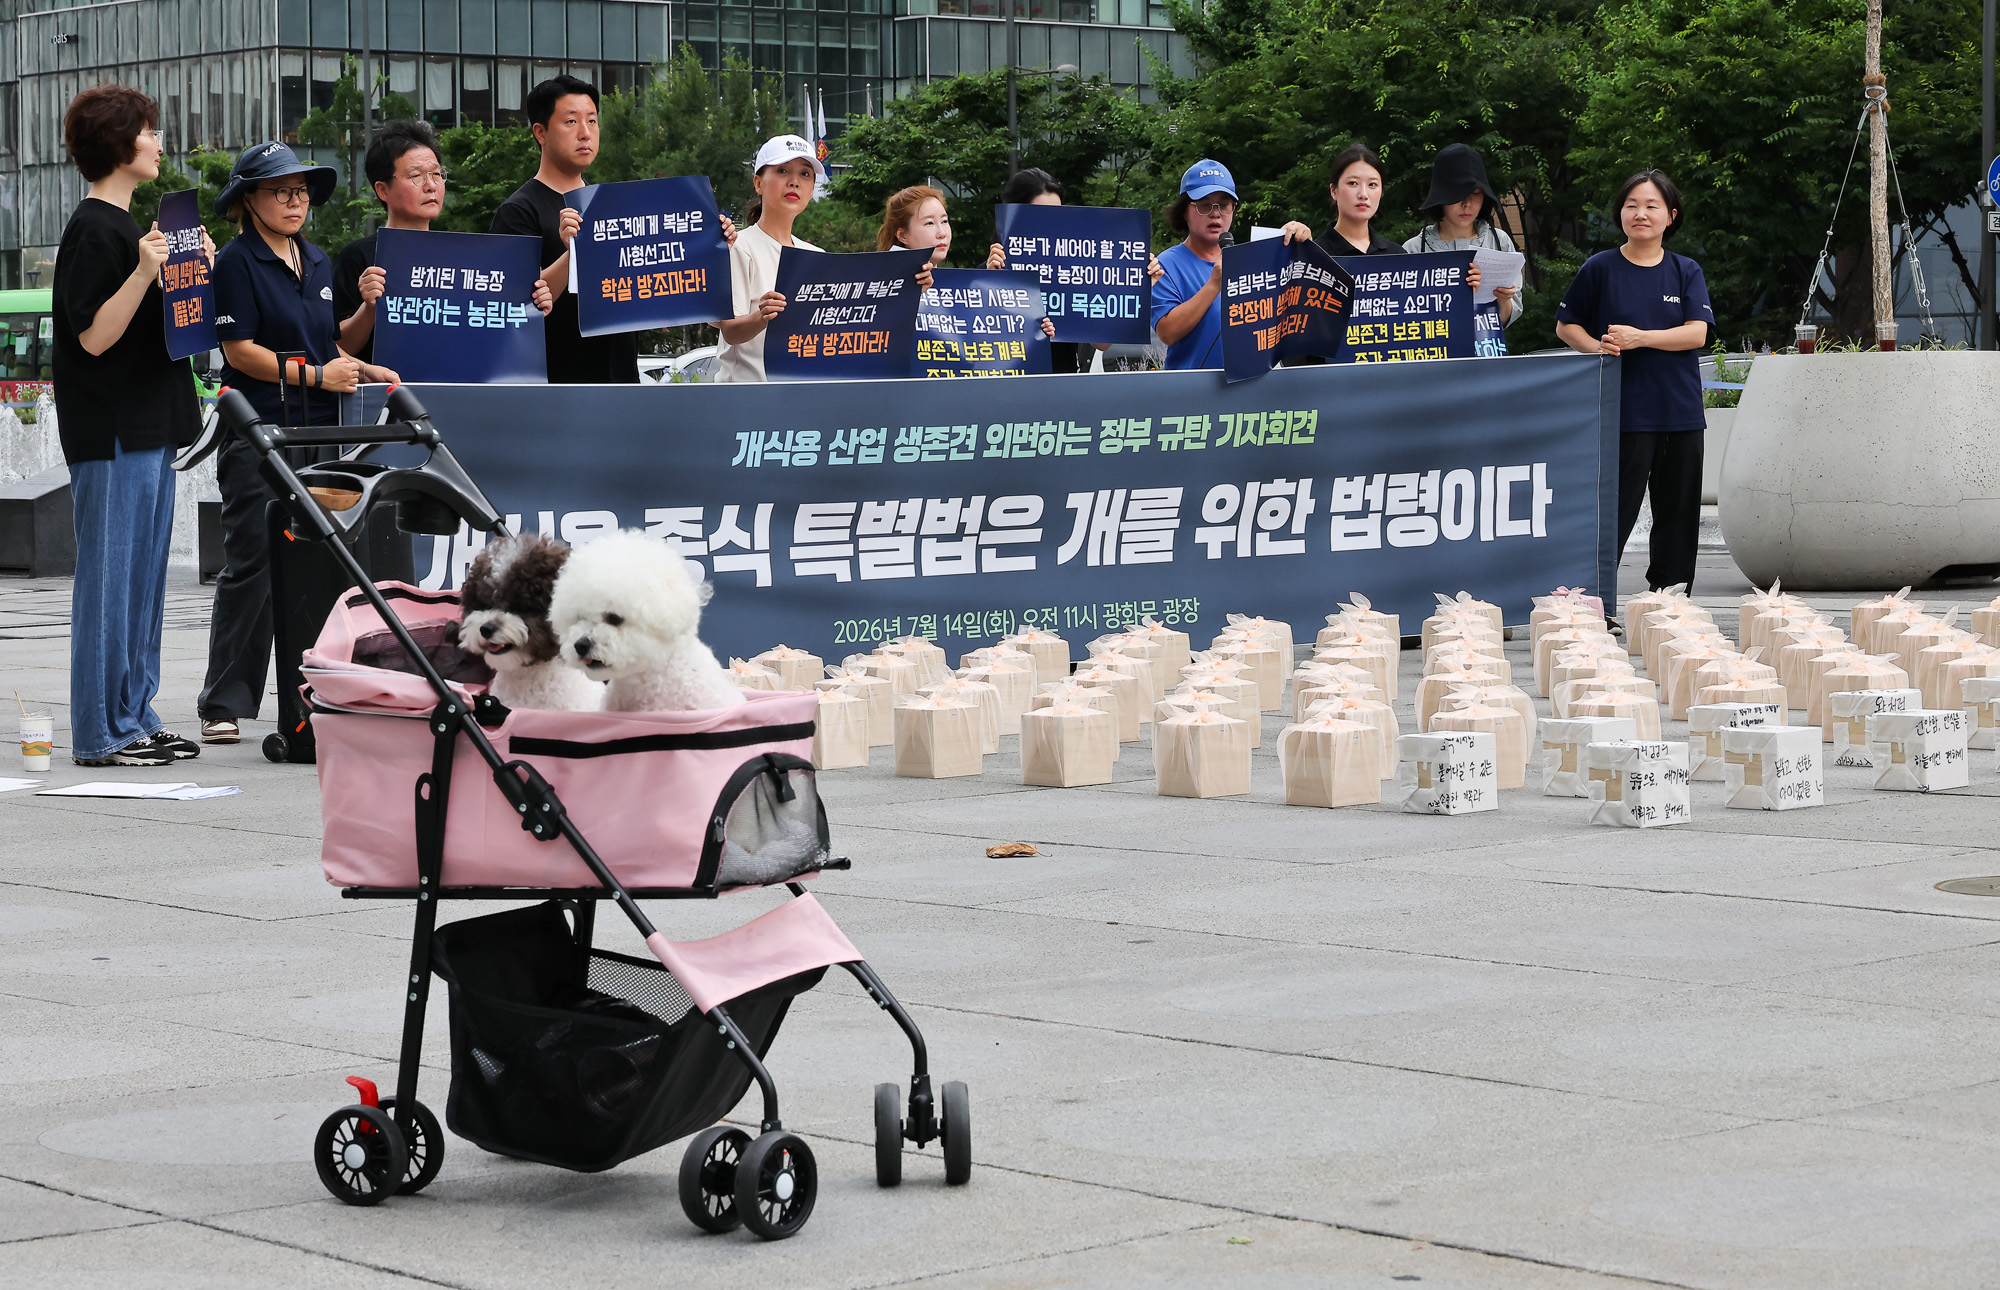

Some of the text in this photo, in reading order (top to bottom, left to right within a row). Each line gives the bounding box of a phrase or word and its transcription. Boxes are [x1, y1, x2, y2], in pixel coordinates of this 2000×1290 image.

[593, 210, 703, 242] 생존견에게 복날은
[619, 241, 686, 268] 사형선고다
[1008, 236, 1146, 261] 정부가 세어야 할 것은
[164, 263, 179, 293] 현장에
[194, 259, 210, 286] 있는
[410, 266, 505, 292] 방치된 개농장
[601, 268, 707, 302] 학살 방조마라!
[1057, 265, 1099, 285] 농장이
[1102, 267, 1144, 286] 아니라
[1226, 270, 1277, 298] 농림부는
[1352, 269, 1419, 292] 식용종식법
[1421, 267, 1461, 287] 시행은
[794, 278, 905, 302] 생존견에게 복날은
[988, 288, 1031, 308] 시행은
[172, 296, 204, 327] 개들을 보라!
[385, 295, 528, 328] 방관하는 농림부
[809, 304, 877, 326] 사형선고다
[1071, 293, 1142, 319] 목숨이다
[1228, 297, 1273, 327] 현장에
[1304, 287, 1343, 314] 있는
[1403, 293, 1452, 315] 쇼인가?
[972, 315, 1025, 334] 쇼인가?
[1346, 319, 1449, 346] 생존견 보호계획
[1474, 312, 1500, 331] 치된
[787, 331, 890, 357] 학살 방조마라!
[917, 340, 1027, 361] 생존견 보호계획
[730, 409, 1319, 469] 개식용 산업 생존견 외면하는 정부 규탄 기자회견
[788, 493, 1044, 584] 특별법은
[1056, 486, 1185, 568] 개를
[1194, 477, 1317, 560] 위한
[1329, 462, 1554, 553] 법령이다
[833, 616, 901, 644] 2026년
[906, 613, 938, 641] 7월
[942, 609, 1016, 639] 14일(화)
[1023, 606, 1059, 633] 오전
[1063, 603, 1097, 630] 11시
[1162, 597, 1200, 625] 광장
[1469, 761, 1476, 778] 수
[1795, 754, 1812, 773] 선한
